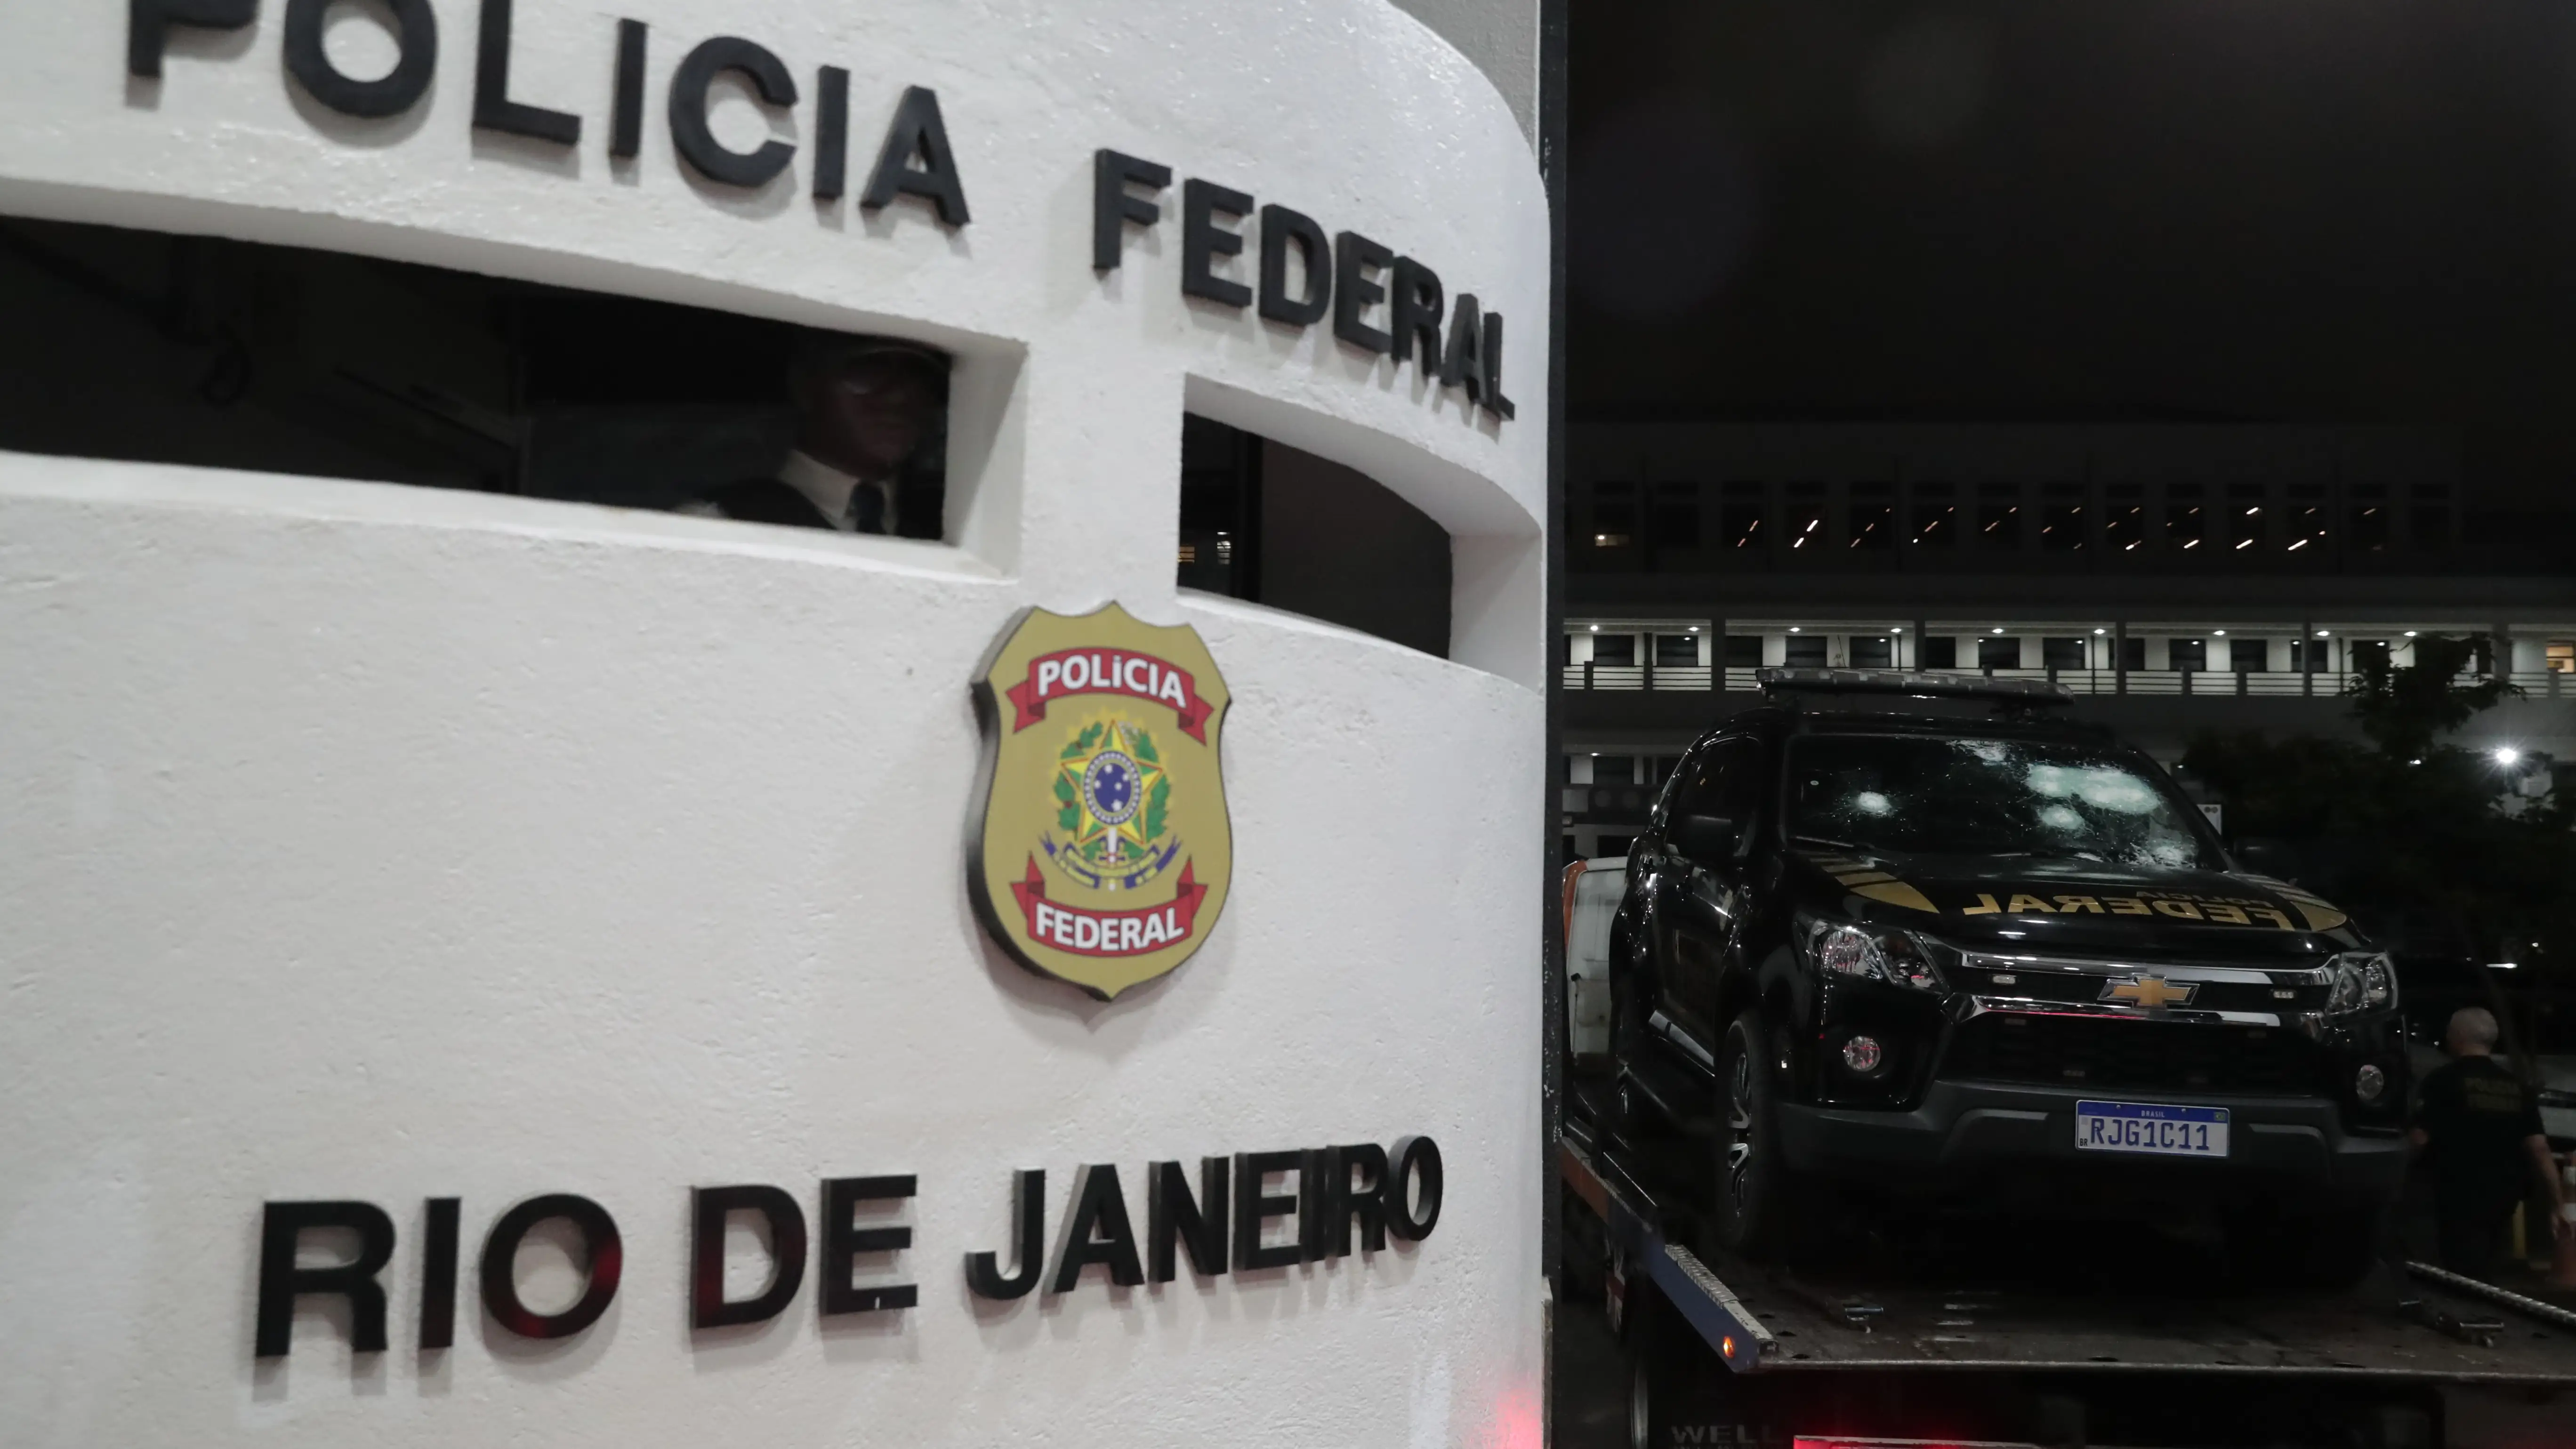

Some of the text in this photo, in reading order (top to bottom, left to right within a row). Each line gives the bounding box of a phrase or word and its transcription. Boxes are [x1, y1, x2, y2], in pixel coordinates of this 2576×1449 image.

[1093, 148, 1516, 420] FEDERAL
[1036, 901, 1184, 951] FEDERAL
[2079, 1138, 2088, 1147] BR
[2091, 1118, 2210, 1151] RJG1C11
[255, 1134, 1444, 1358] RIO DE JANEIRO
